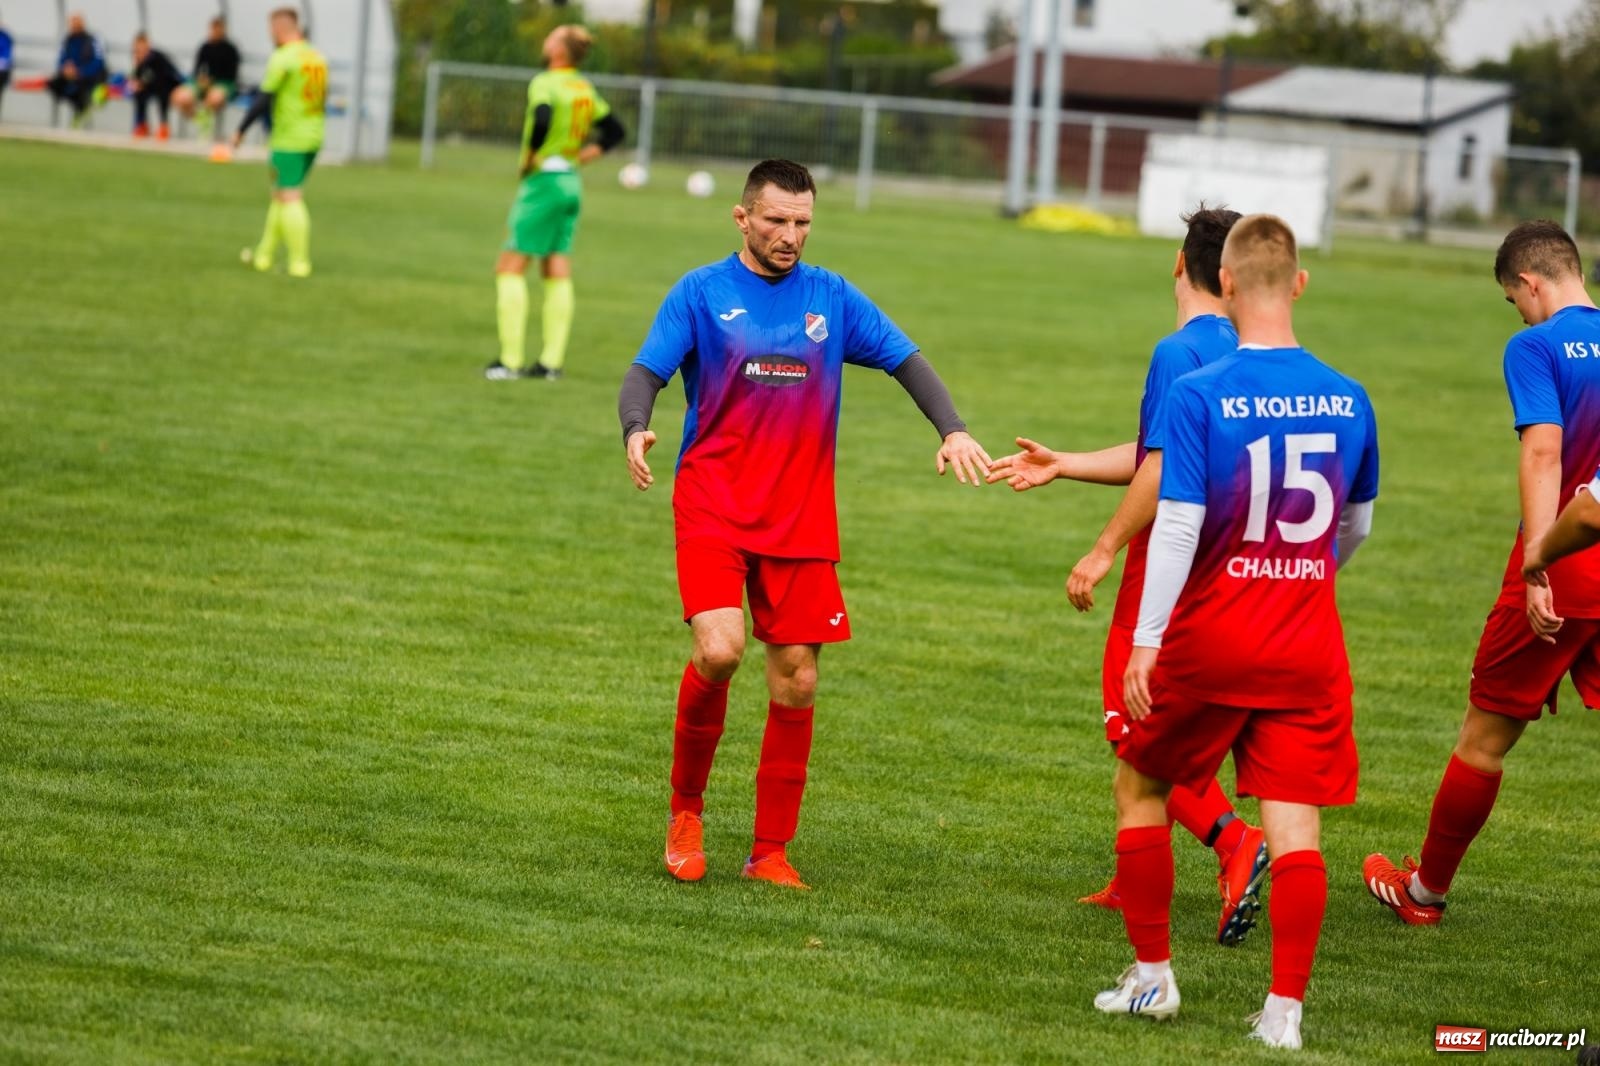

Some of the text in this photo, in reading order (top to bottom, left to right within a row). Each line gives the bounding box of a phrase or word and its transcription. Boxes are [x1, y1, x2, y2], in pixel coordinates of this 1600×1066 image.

[1563, 342, 1588, 359] KS
[745, 362, 808, 375] MILION
[1221, 395, 1355, 418] KS KOLEJARZ
[1242, 432, 1337, 544] 15
[1226, 556, 1325, 580] CHAŁUPKI
